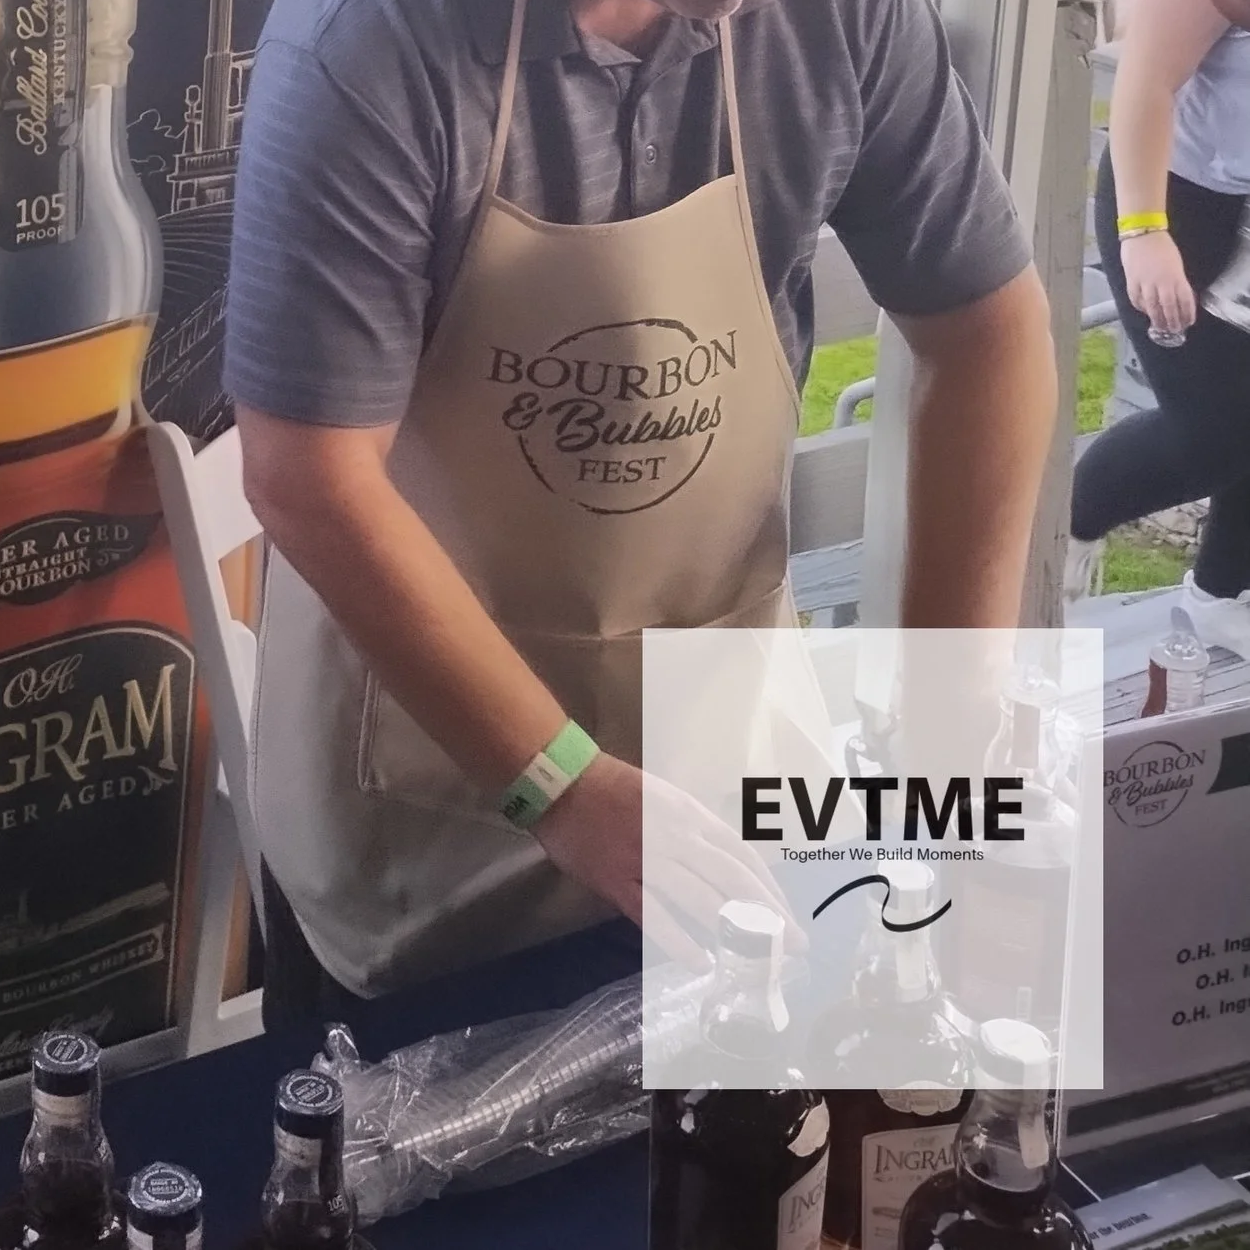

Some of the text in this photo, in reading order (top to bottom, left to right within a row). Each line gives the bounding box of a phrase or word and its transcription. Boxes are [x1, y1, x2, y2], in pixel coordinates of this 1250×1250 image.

[15, 46, 48, 155] Ballard
[15, 193, 66, 228] 105
[15, 226, 66, 244] PROOF
[486, 329, 737, 400] BOURBON
[546, 395, 722, 452] Bubbles
[576, 456, 666, 483] FEST
[53, 524, 130, 550] AGED
[1103, 750, 1206, 787] BOURBON
[57, 776, 137, 813] AGED
[1123, 774, 1194, 807] Bubbles
[1135, 799, 1168, 816] FEST
[1176, 942, 1216, 965] O.H.
[1196, 968, 1235, 990] O.H.
[1171, 1005, 1211, 1026] O.H.
[874, 1144, 958, 1174] INGRA
